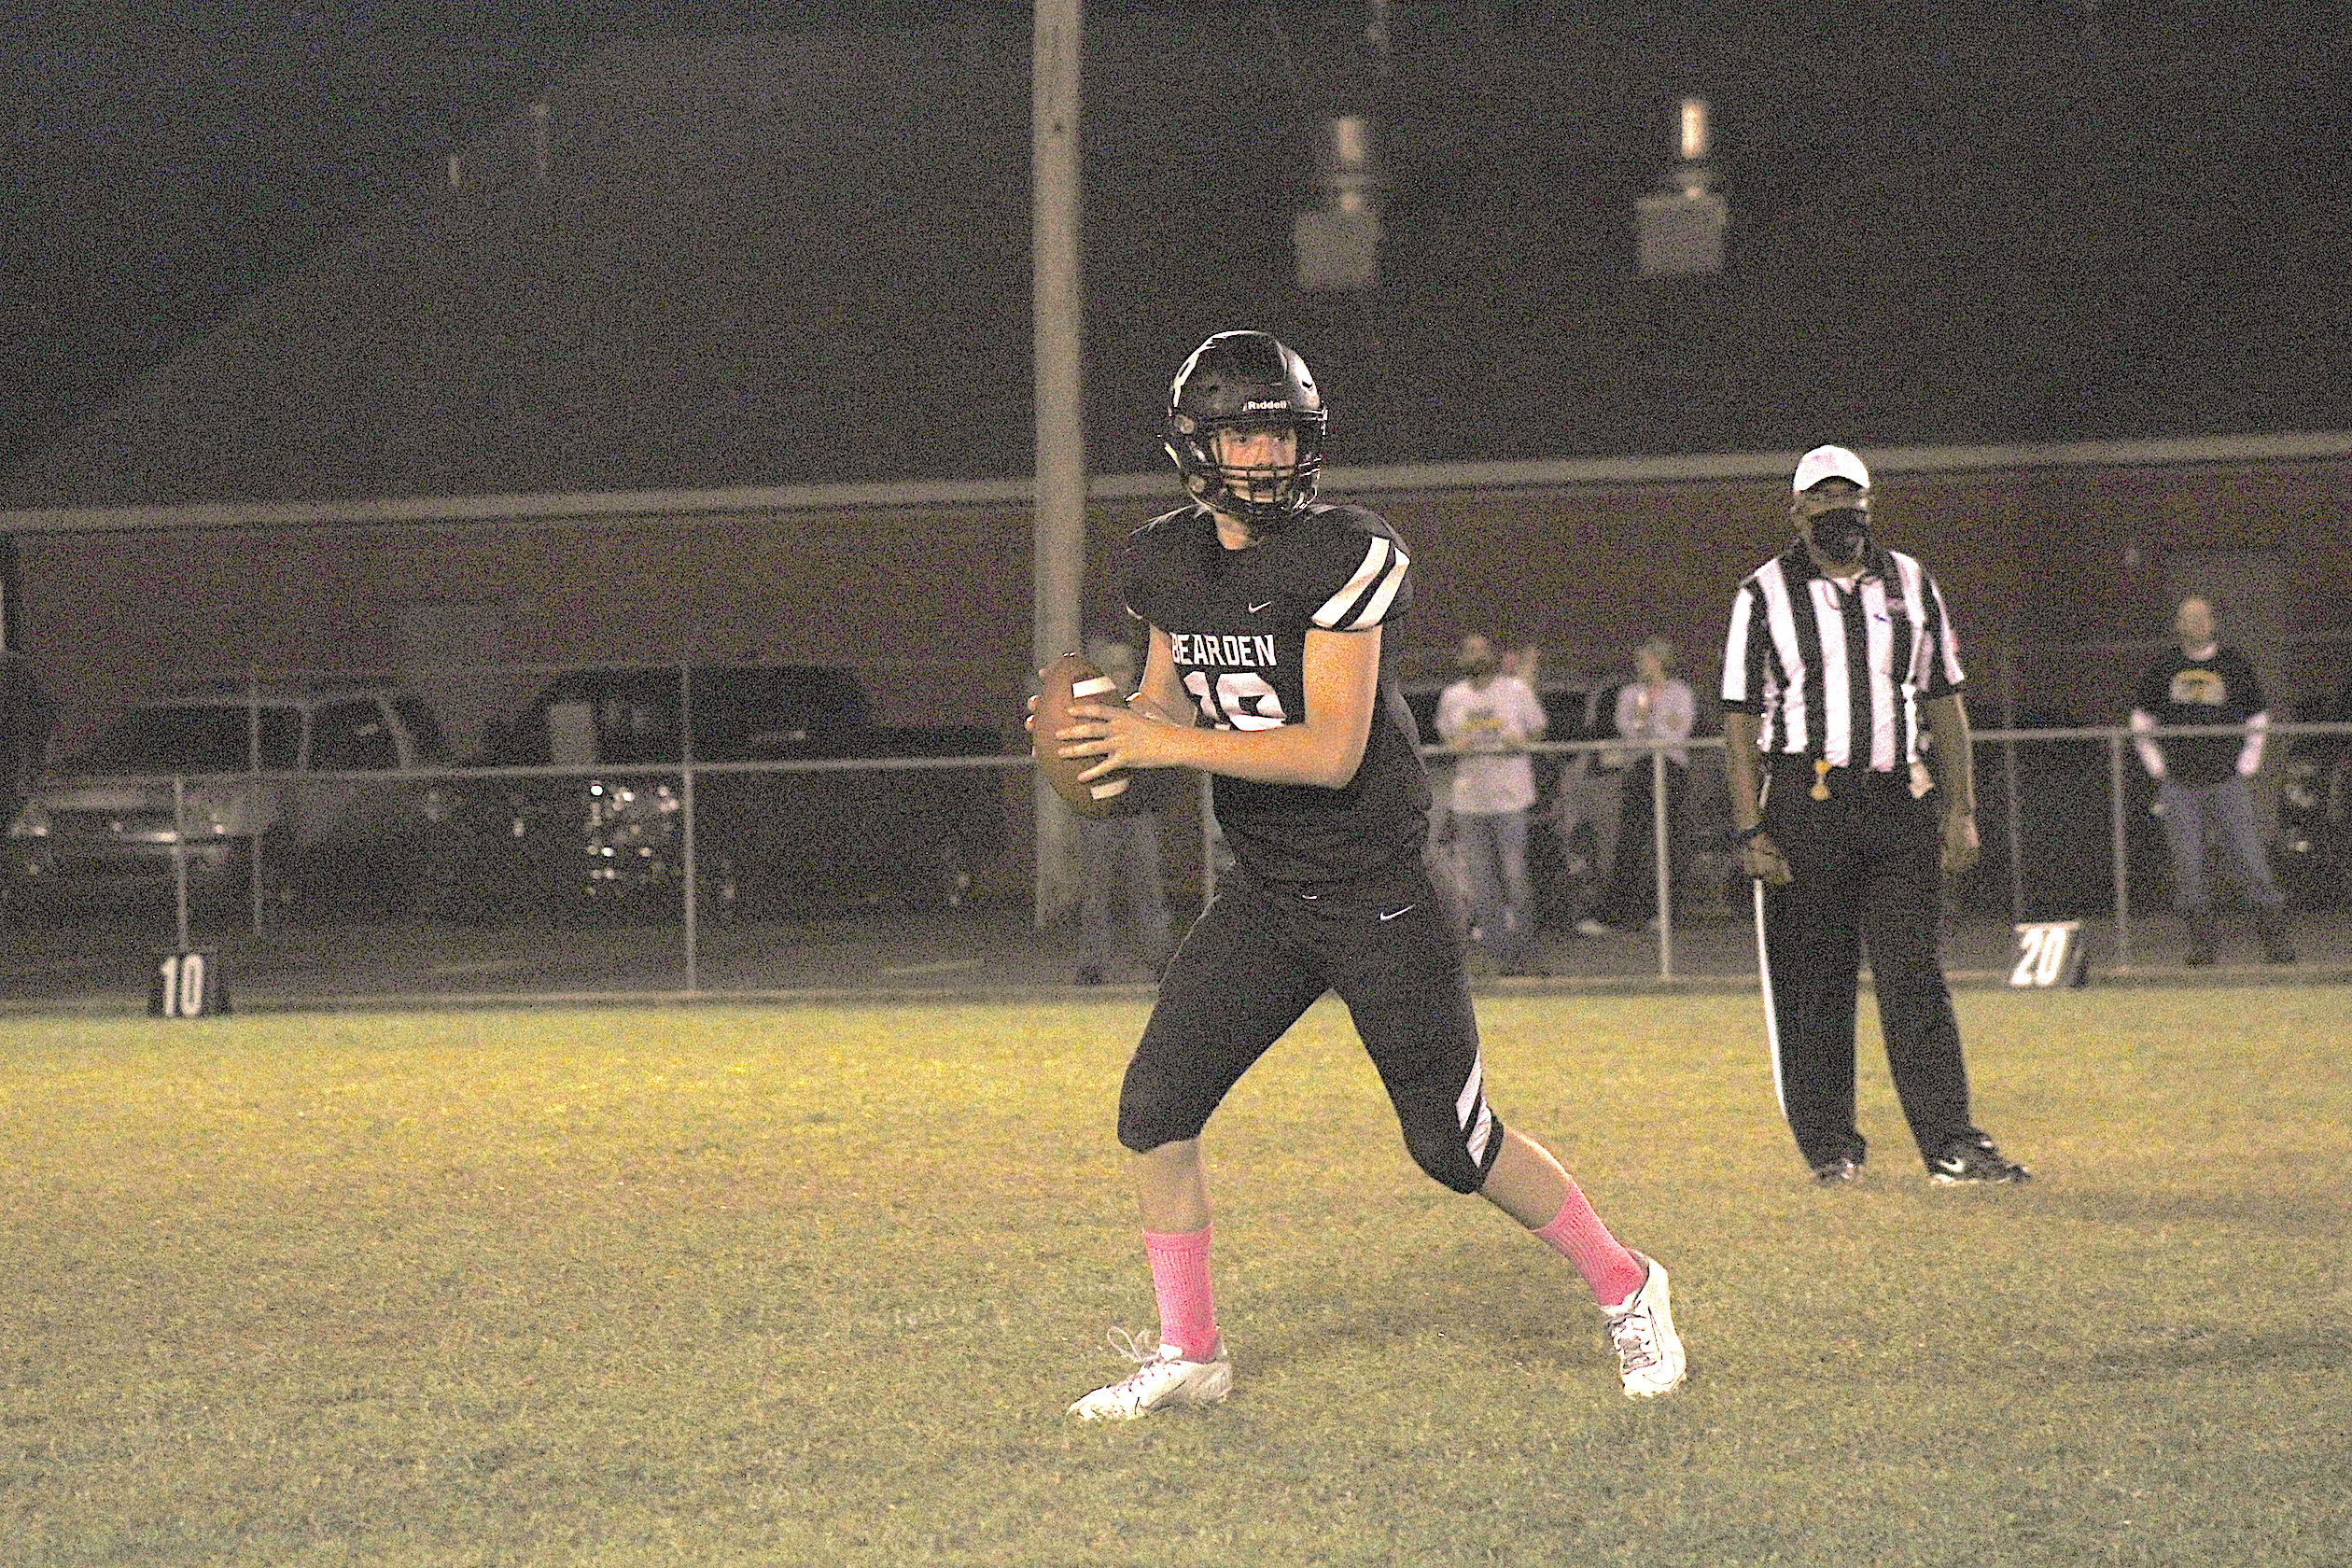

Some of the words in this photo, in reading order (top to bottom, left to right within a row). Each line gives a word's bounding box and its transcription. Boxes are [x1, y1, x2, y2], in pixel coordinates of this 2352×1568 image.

[1247, 400, 1287, 411] Riddell
[1170, 632, 1279, 667] BEARDEN
[2010, 923, 2066, 987] 20
[160, 953, 203, 1016] 10
